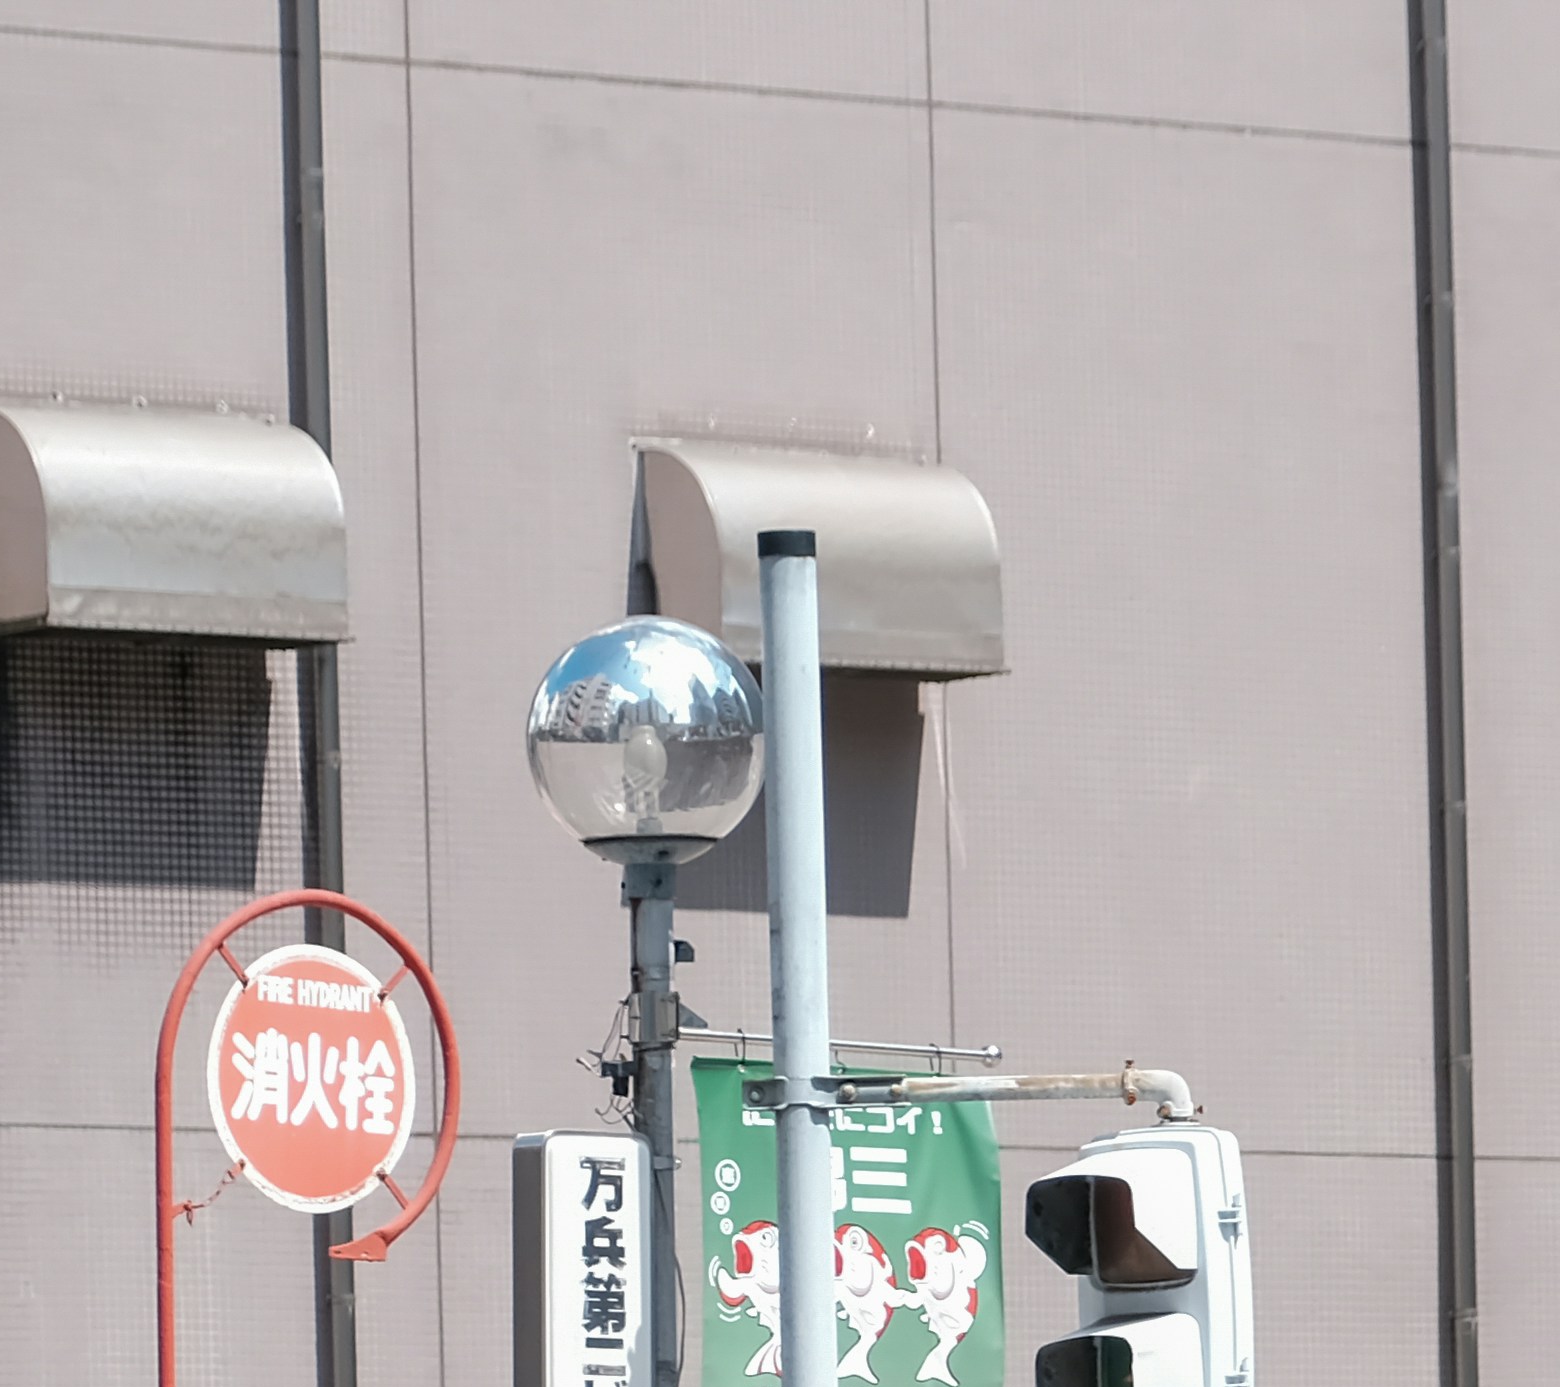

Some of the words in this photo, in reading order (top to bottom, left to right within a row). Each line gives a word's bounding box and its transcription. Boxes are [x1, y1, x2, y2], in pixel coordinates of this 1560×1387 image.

[257, 974, 294, 1005] FIRE
[297, 978, 373, 1014] HYDRANT
[230, 1027, 396, 1136] 消火栓
